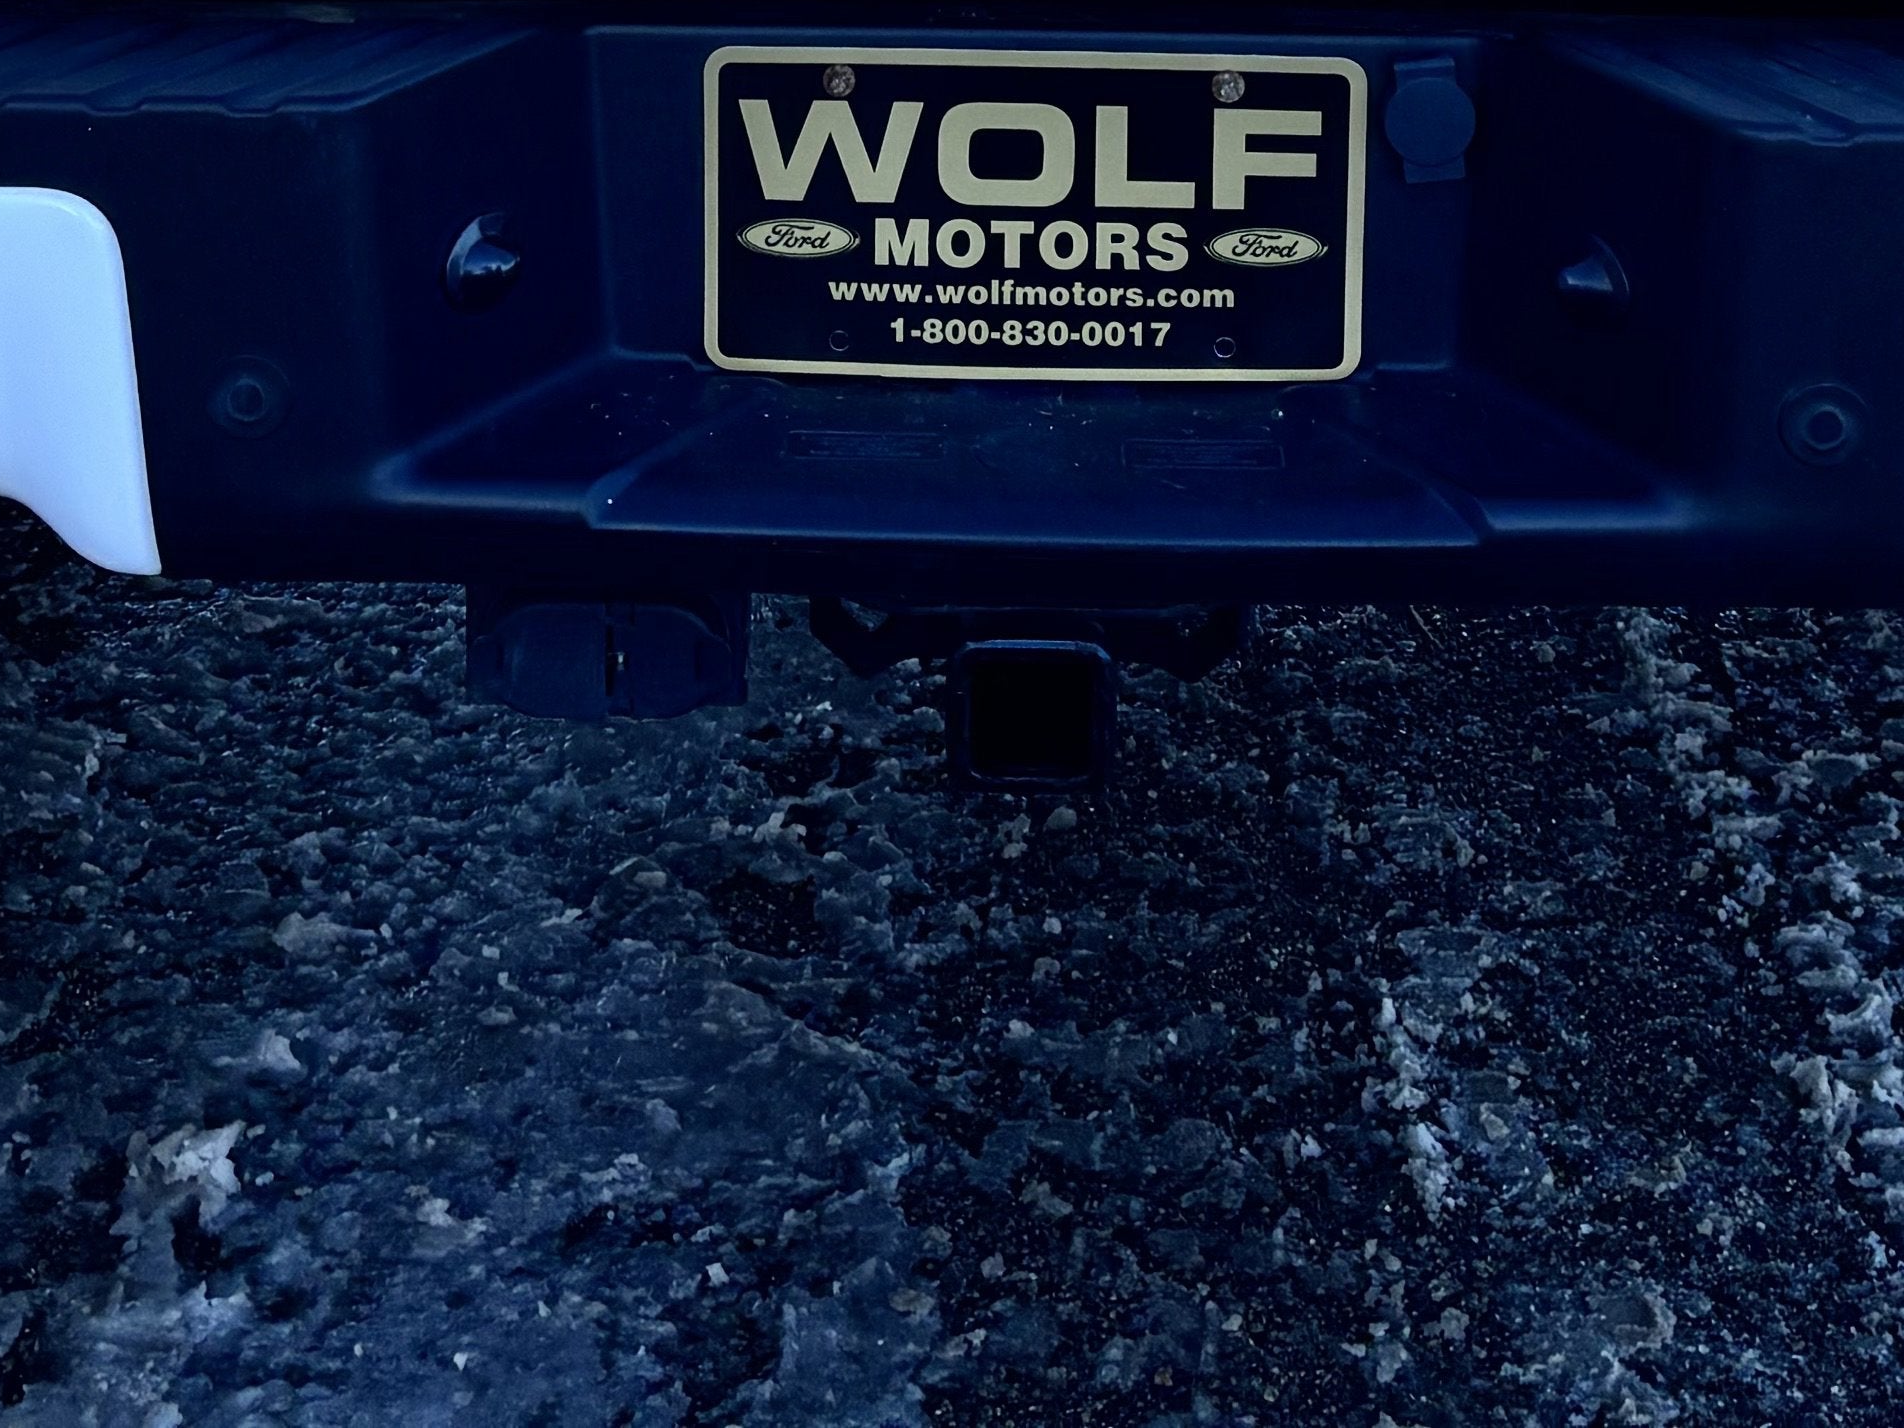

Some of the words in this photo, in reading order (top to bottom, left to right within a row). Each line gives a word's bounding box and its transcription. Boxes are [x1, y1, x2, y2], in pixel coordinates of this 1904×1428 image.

[738, 98, 1323, 210] WOLF
[764, 224, 831, 249] Ford
[873, 218, 1190, 271] MOTORS
[1232, 233, 1299, 258] Ford
[828, 279, 1236, 309] www.wolfmotors.com
[889, 317, 1171, 347] 1-800-830-0017
